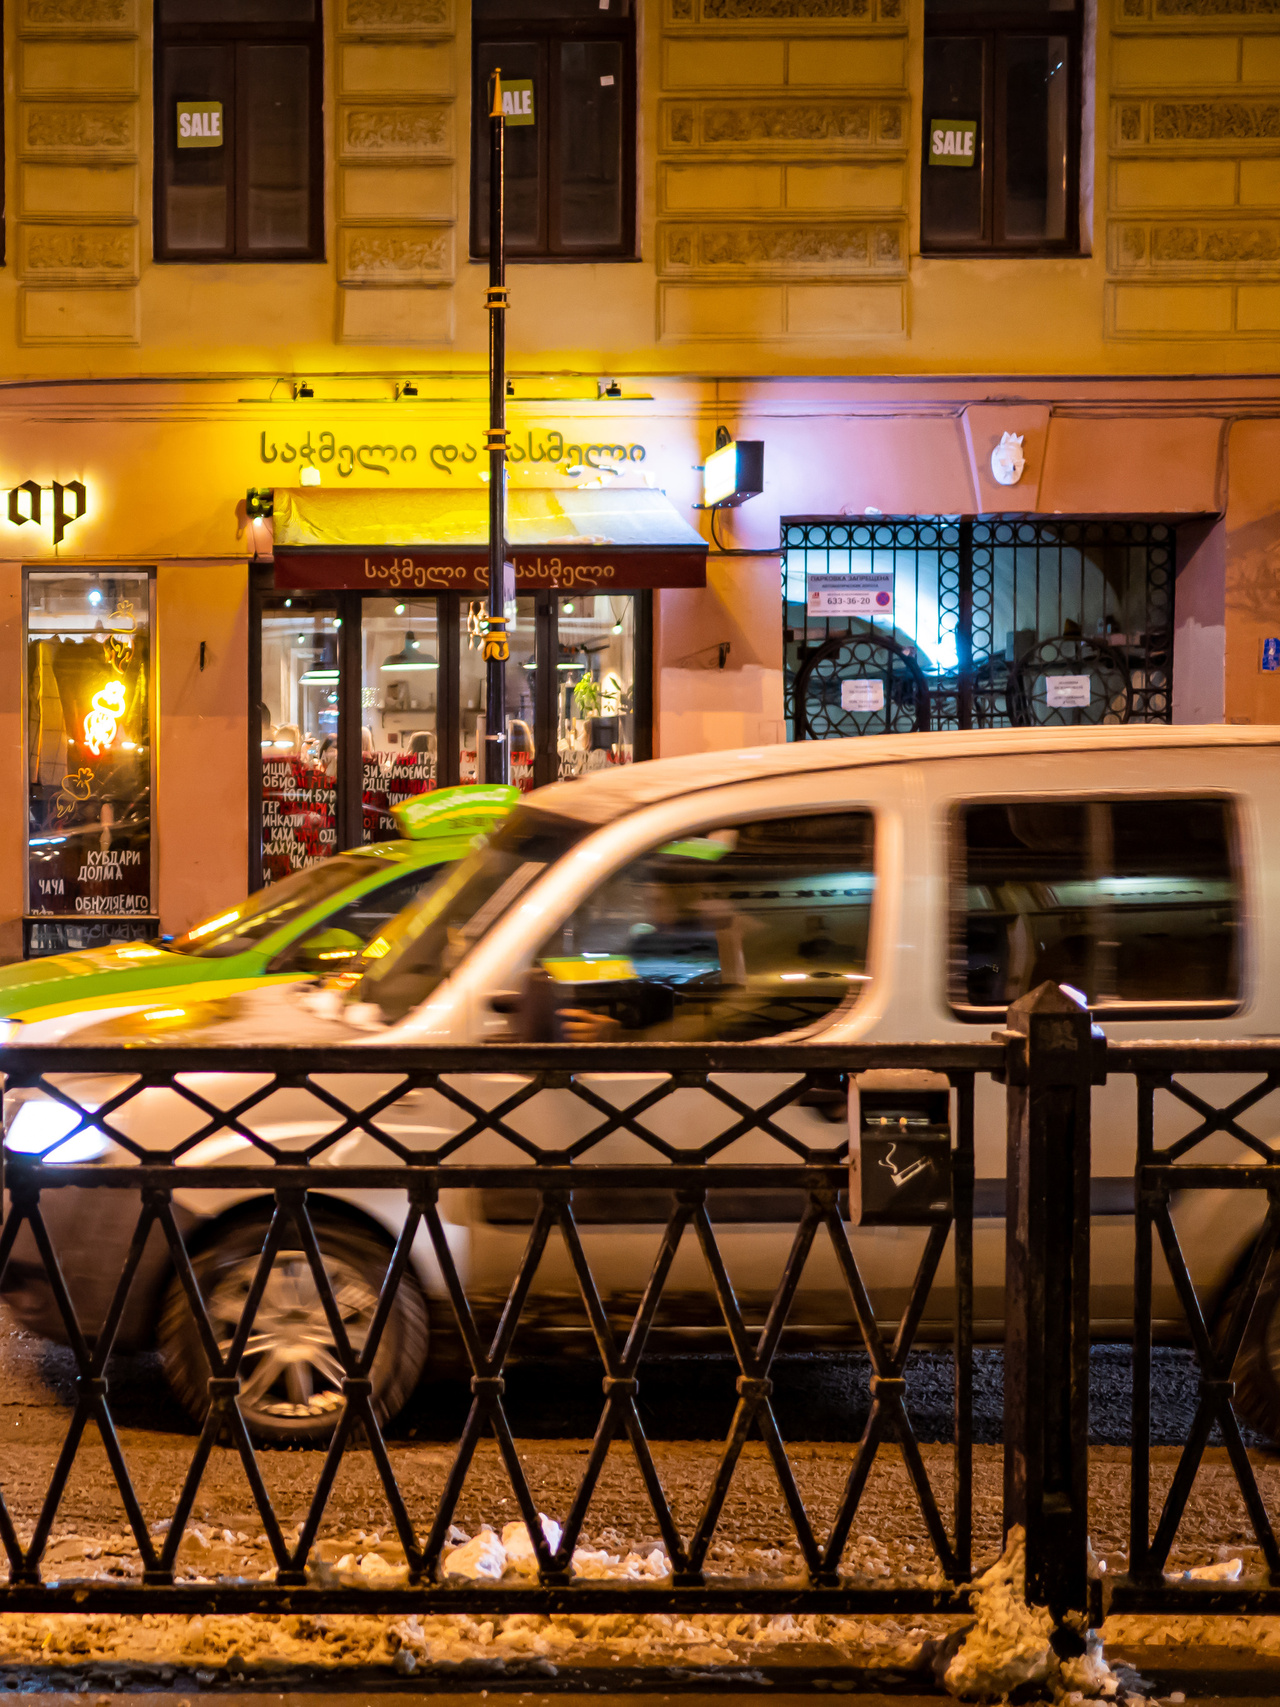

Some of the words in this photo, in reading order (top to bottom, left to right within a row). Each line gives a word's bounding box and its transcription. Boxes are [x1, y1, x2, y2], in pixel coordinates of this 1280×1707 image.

[502, 90, 532, 115] ALE
[180, 112, 220, 137] SALE
[932, 129, 974, 156] SALE
[506, 431, 646, 476] ასმელი
[826, 597, 871, 605] 633-36-20
[87, 850, 141, 866] КУБДАРИ
[77, 864, 123, 882] ДОЛМА
[38, 879, 65, 895] ЧАЧА
